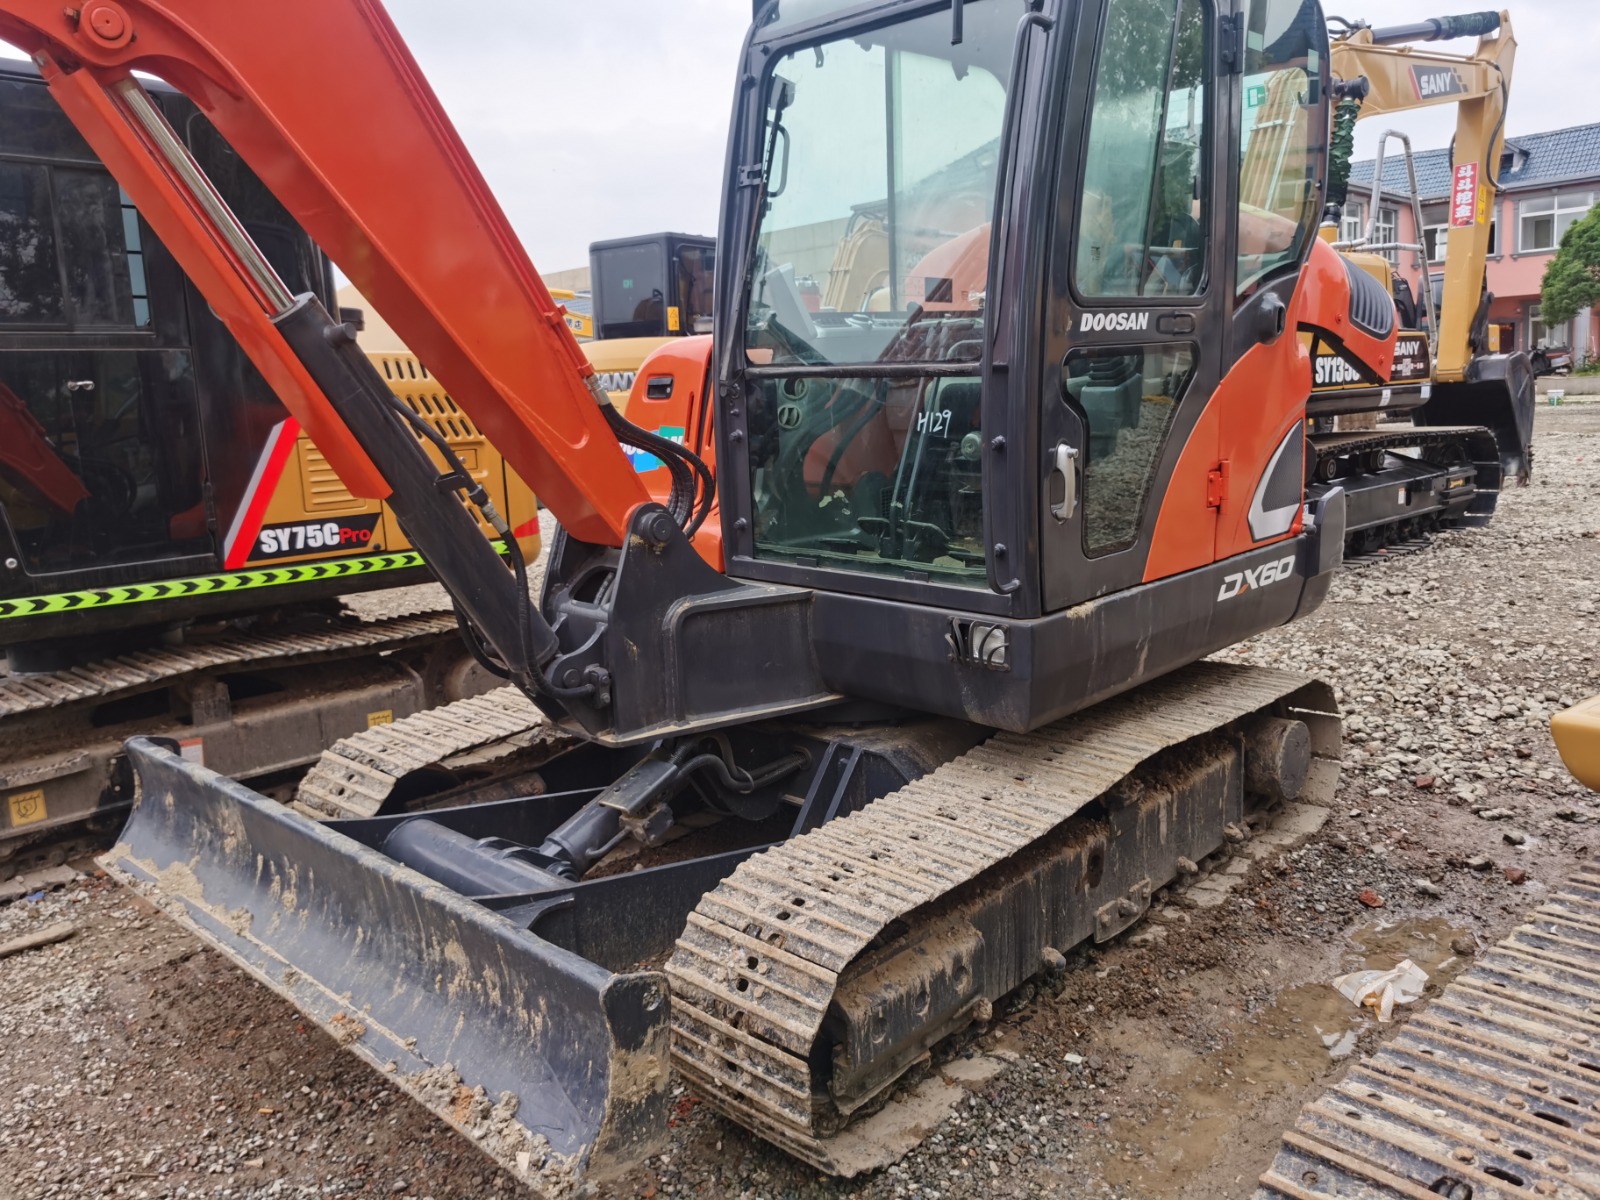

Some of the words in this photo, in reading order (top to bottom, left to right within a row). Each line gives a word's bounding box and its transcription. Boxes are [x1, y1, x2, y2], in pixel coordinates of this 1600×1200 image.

[1420, 72, 1451, 95] SANY
[1080, 312, 1149, 331] DOOSAN
[597, 371, 636, 392] ANY
[917, 409, 952, 438] H129
[260, 522, 341, 553] SY75C
[340, 527, 371, 544] Pro
[1217, 554, 1296, 602] DX60
